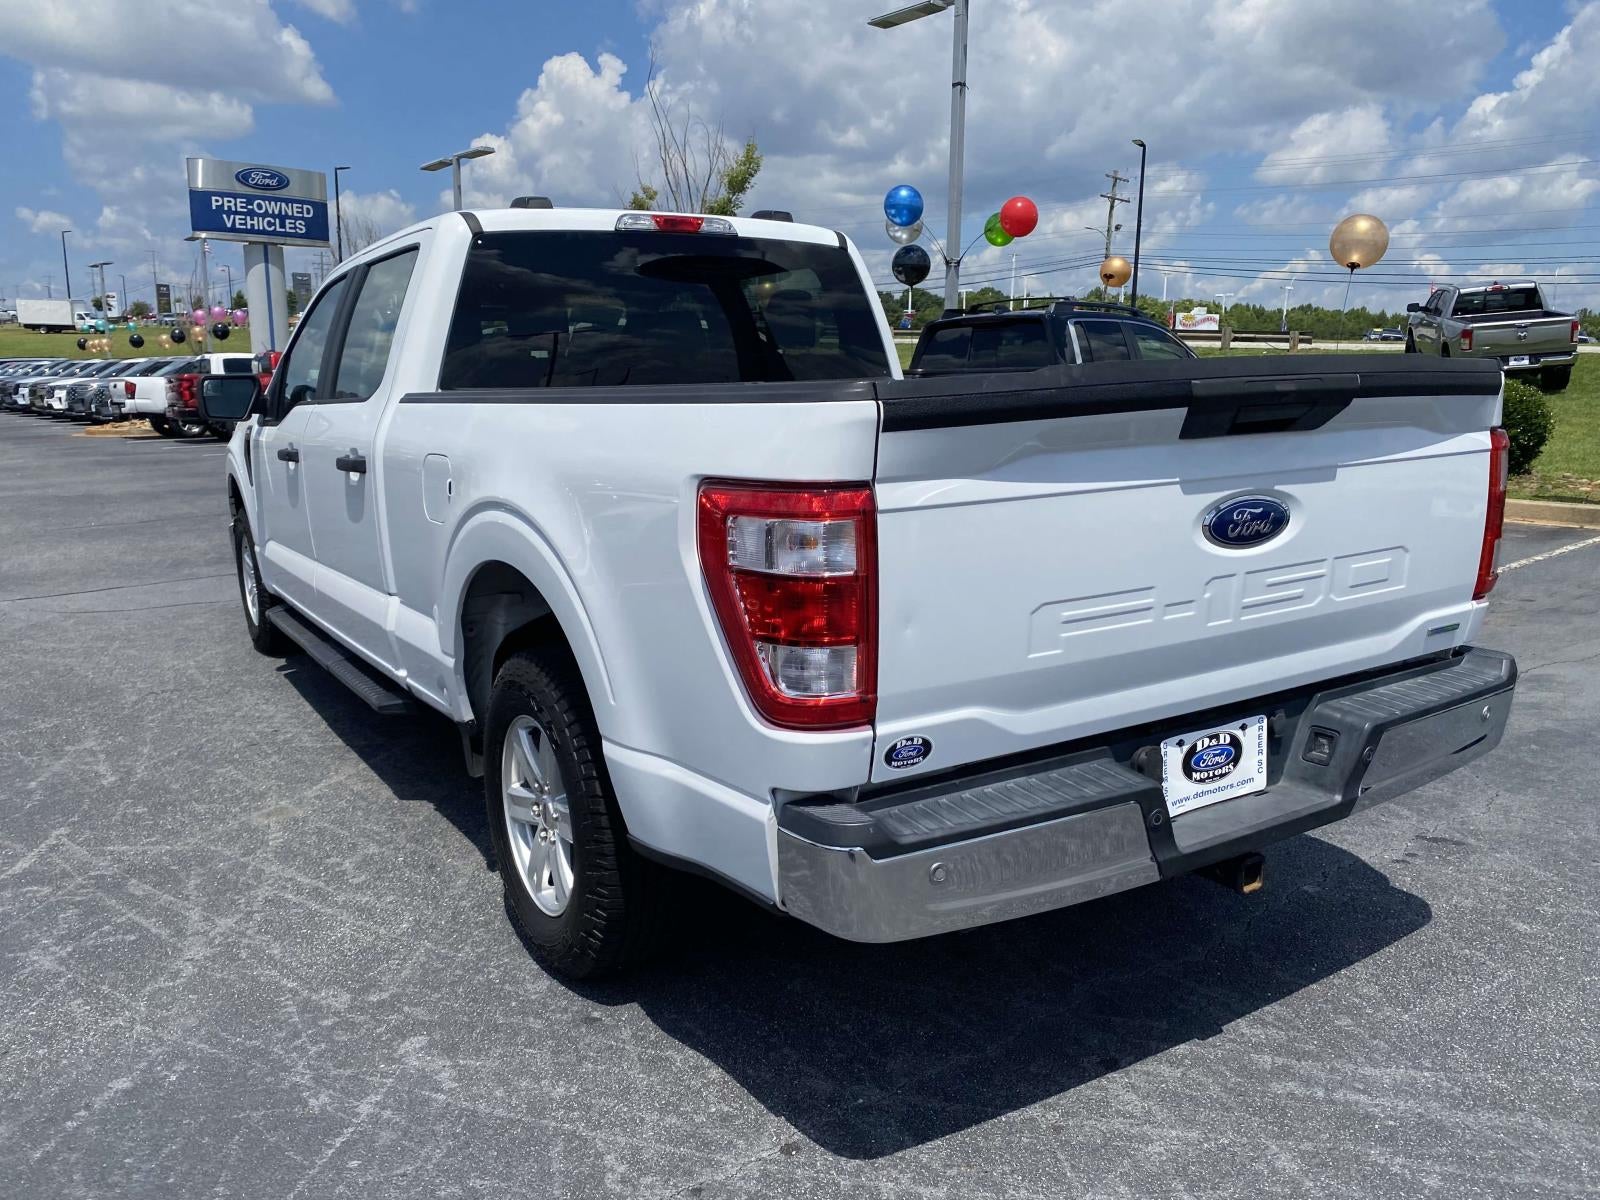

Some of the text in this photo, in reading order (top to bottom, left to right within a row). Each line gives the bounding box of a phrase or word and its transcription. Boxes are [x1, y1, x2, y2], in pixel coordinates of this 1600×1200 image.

[249, 171, 278, 187] Ford
[211, 196, 314, 218] PRE-OWNED
[222, 214, 306, 233] VEHICLES
[1228, 507, 1275, 538] Ford
[1027, 545, 1410, 659] F-150
[1195, 733, 1231, 753] D&D
[1200, 750, 1227, 767] Ford
[1192, 762, 1234, 781] MOTORS
[1171, 776, 1255, 808] www.ddmotors.com
